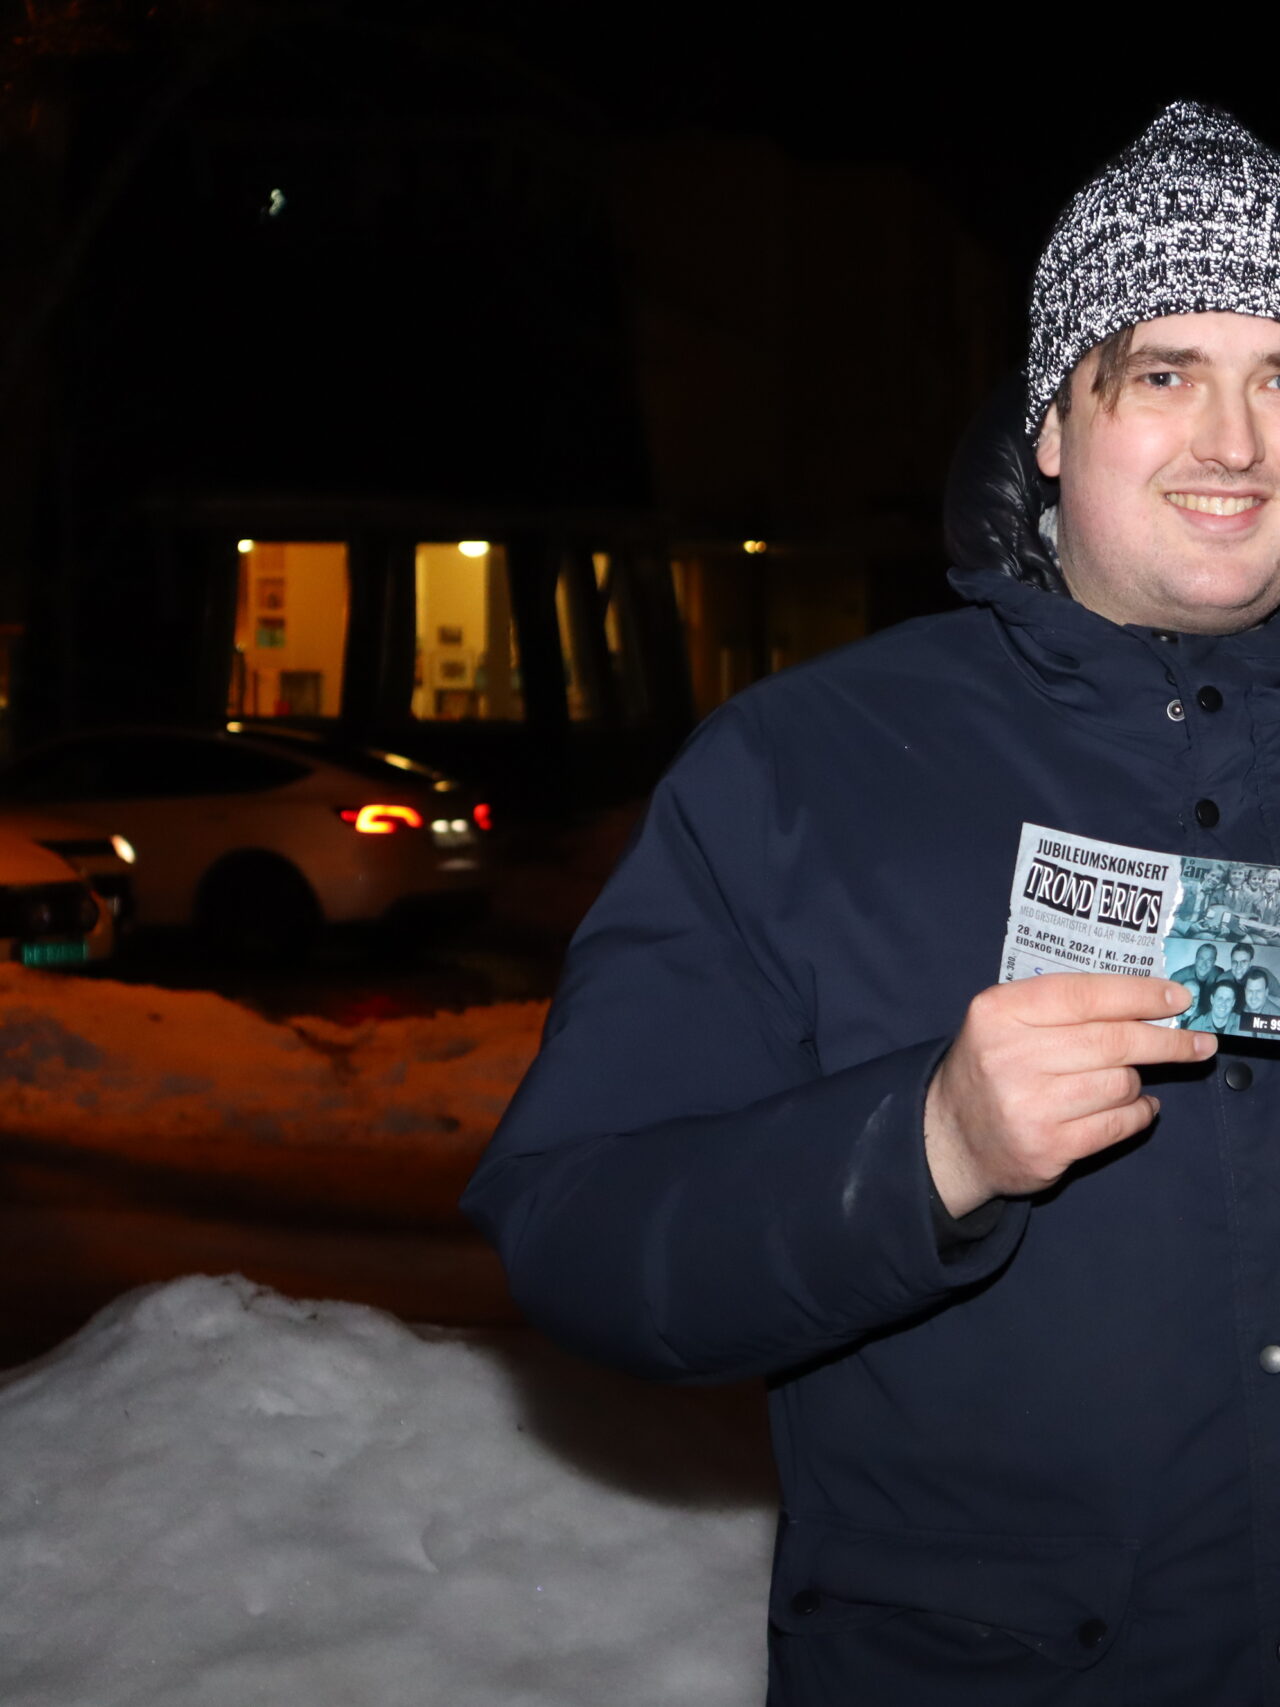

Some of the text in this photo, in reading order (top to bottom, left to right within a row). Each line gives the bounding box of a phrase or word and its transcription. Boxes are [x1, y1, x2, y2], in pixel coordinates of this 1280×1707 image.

[1036, 838, 1170, 882] JUBILEUMSKONSERT
[1020, 905, 1034, 917] MED
[1027, 862, 1161, 929] TROND ERICS
[1015, 935, 1052, 954] EIDSKOG
[1099, 961, 1151, 977] SKOTTERUD
[1017, 924, 1032, 937] 28.
[1035, 930, 1065, 947] APRIL
[1069, 940, 1095, 955] 2024
[1122, 953, 1154, 966] 20:00
[1253, 1016, 1268, 1029] Nr:
